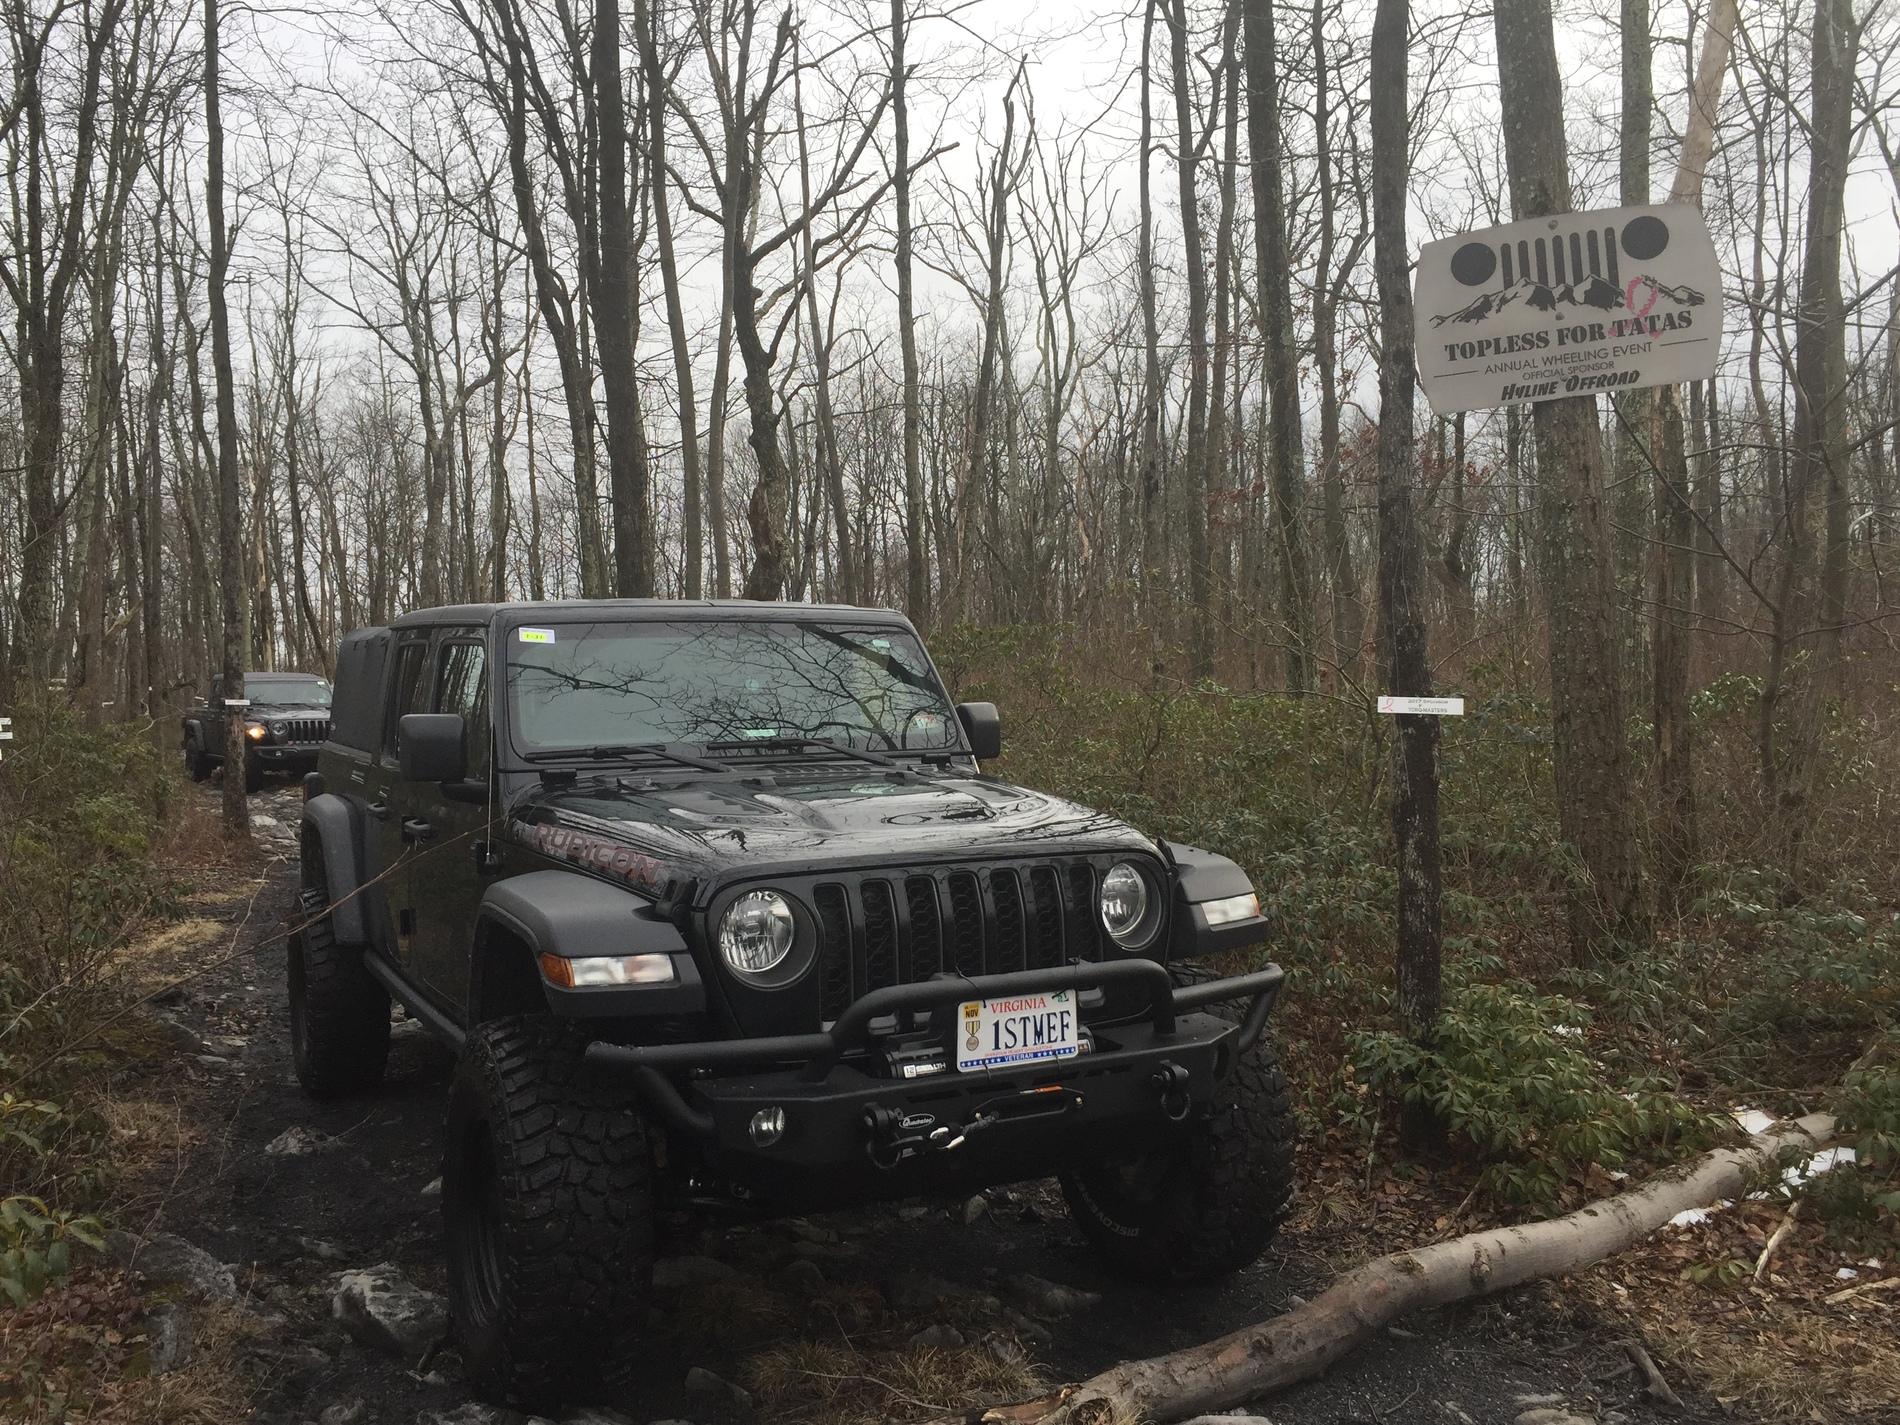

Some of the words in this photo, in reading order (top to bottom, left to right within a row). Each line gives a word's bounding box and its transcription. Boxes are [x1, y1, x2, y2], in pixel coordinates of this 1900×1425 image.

[1444, 330, 1550, 362] TOPLESS
[1557, 323, 1607, 347] FOR
[1612, 310, 1694, 338] TATAS
[1484, 356, 1539, 376] ANNUAL
[1543, 346, 1609, 368] WHEELING
[1613, 341, 1653, 357] EVENT
[1522, 367, 1566, 381] OFFICIAL
[1567, 360, 1615, 376] SPONSOR
[1565, 370, 1641, 392] OFFROAD
[534, 822, 665, 887] RUBICON
[965, 1008, 979, 1019] NOV
[990, 996, 1047, 1014] VIRGINIA
[991, 1010, 1072, 1051] 1STMEF
[1004, 1052, 1034, 1063] VETERAN
